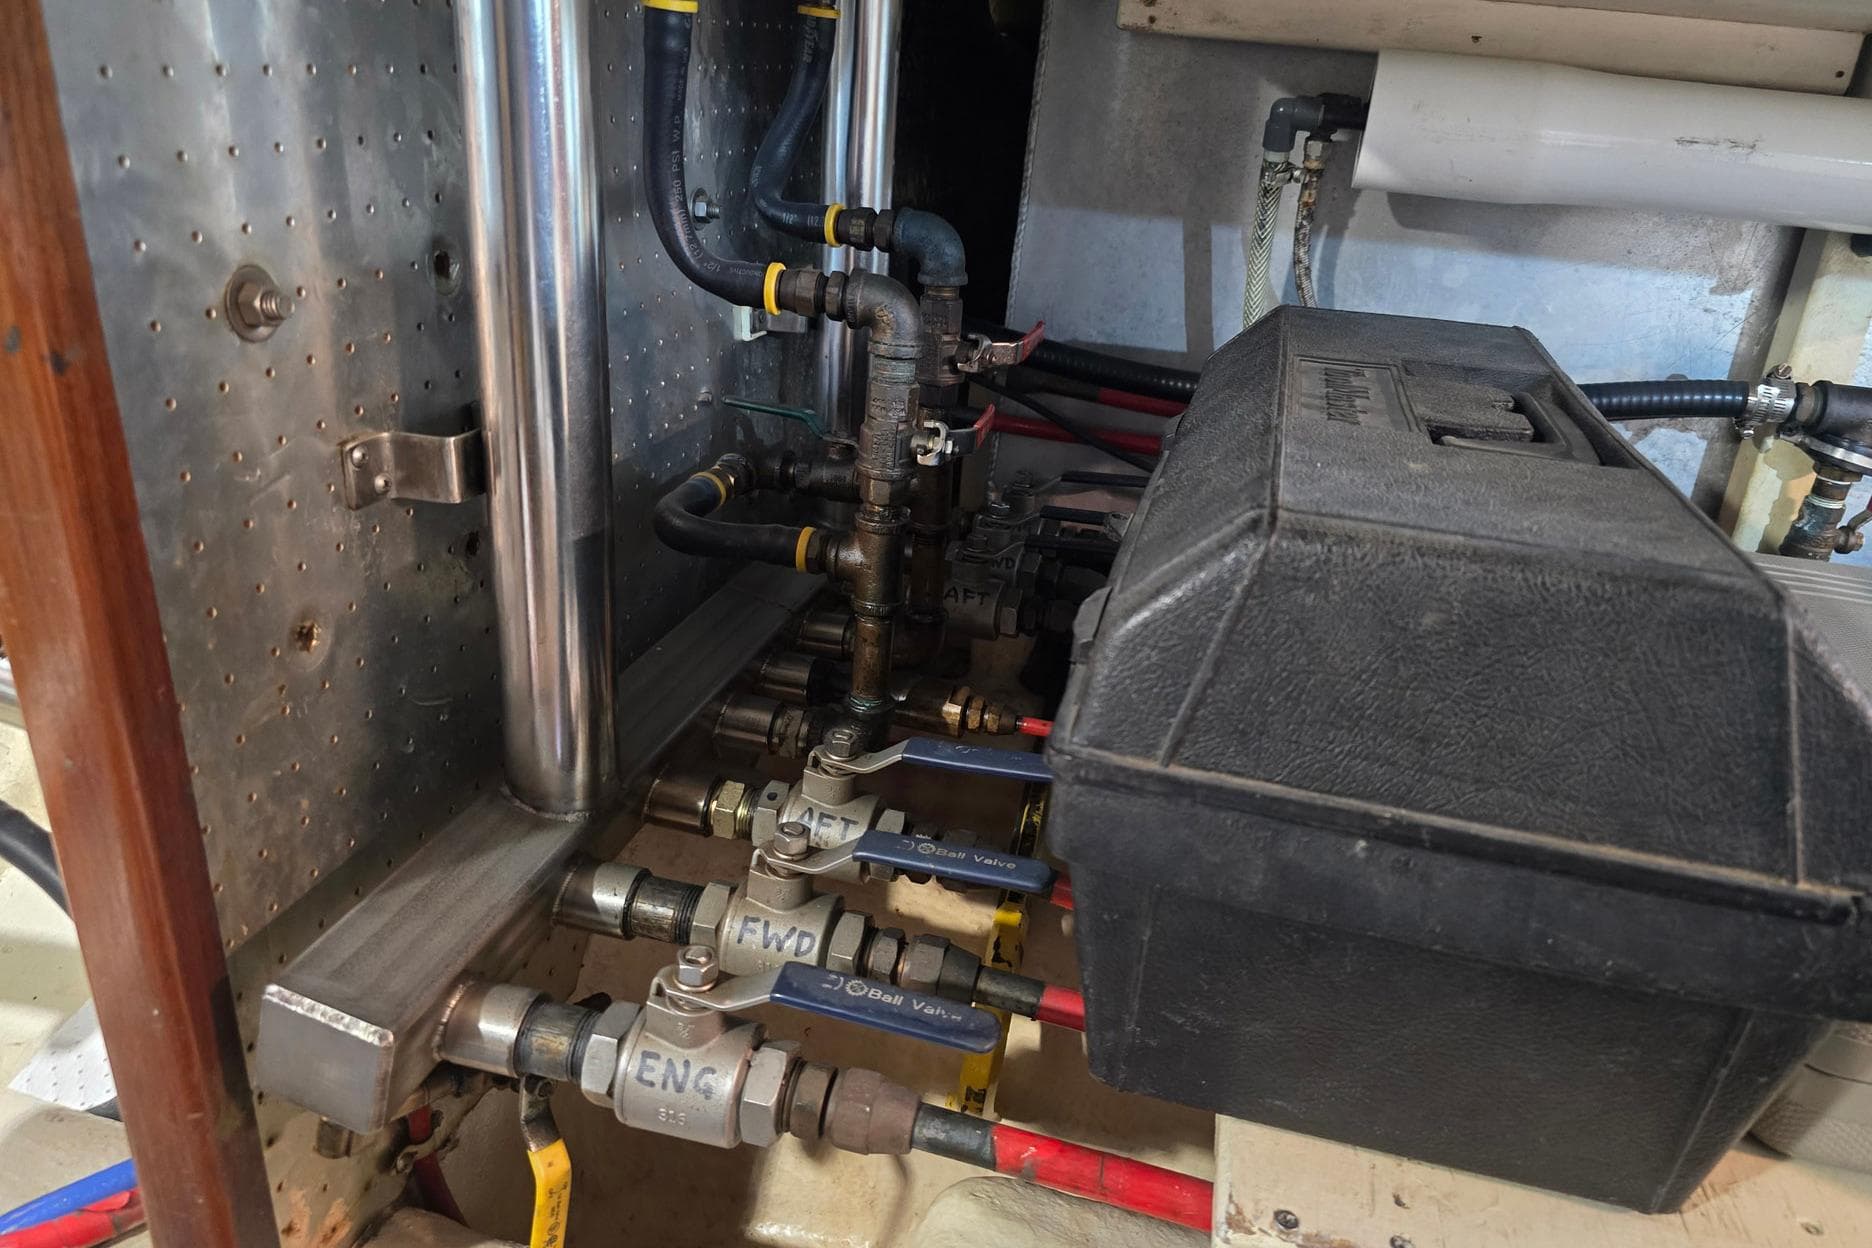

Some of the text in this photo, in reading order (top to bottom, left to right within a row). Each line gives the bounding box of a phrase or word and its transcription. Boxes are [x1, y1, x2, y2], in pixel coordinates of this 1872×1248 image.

[671, 150, 681, 172] PSI
[673, 179, 684, 202] 250
[991, 557, 1015, 570] WD
[943, 586, 991, 606] AFT
[795, 806, 860, 841] AFT
[935, 847, 1017, 870] Ball Valve
[735, 915, 817, 957] FWD
[867, 987, 905, 1007] Ball
[634, 1050, 717, 1100] ENG
